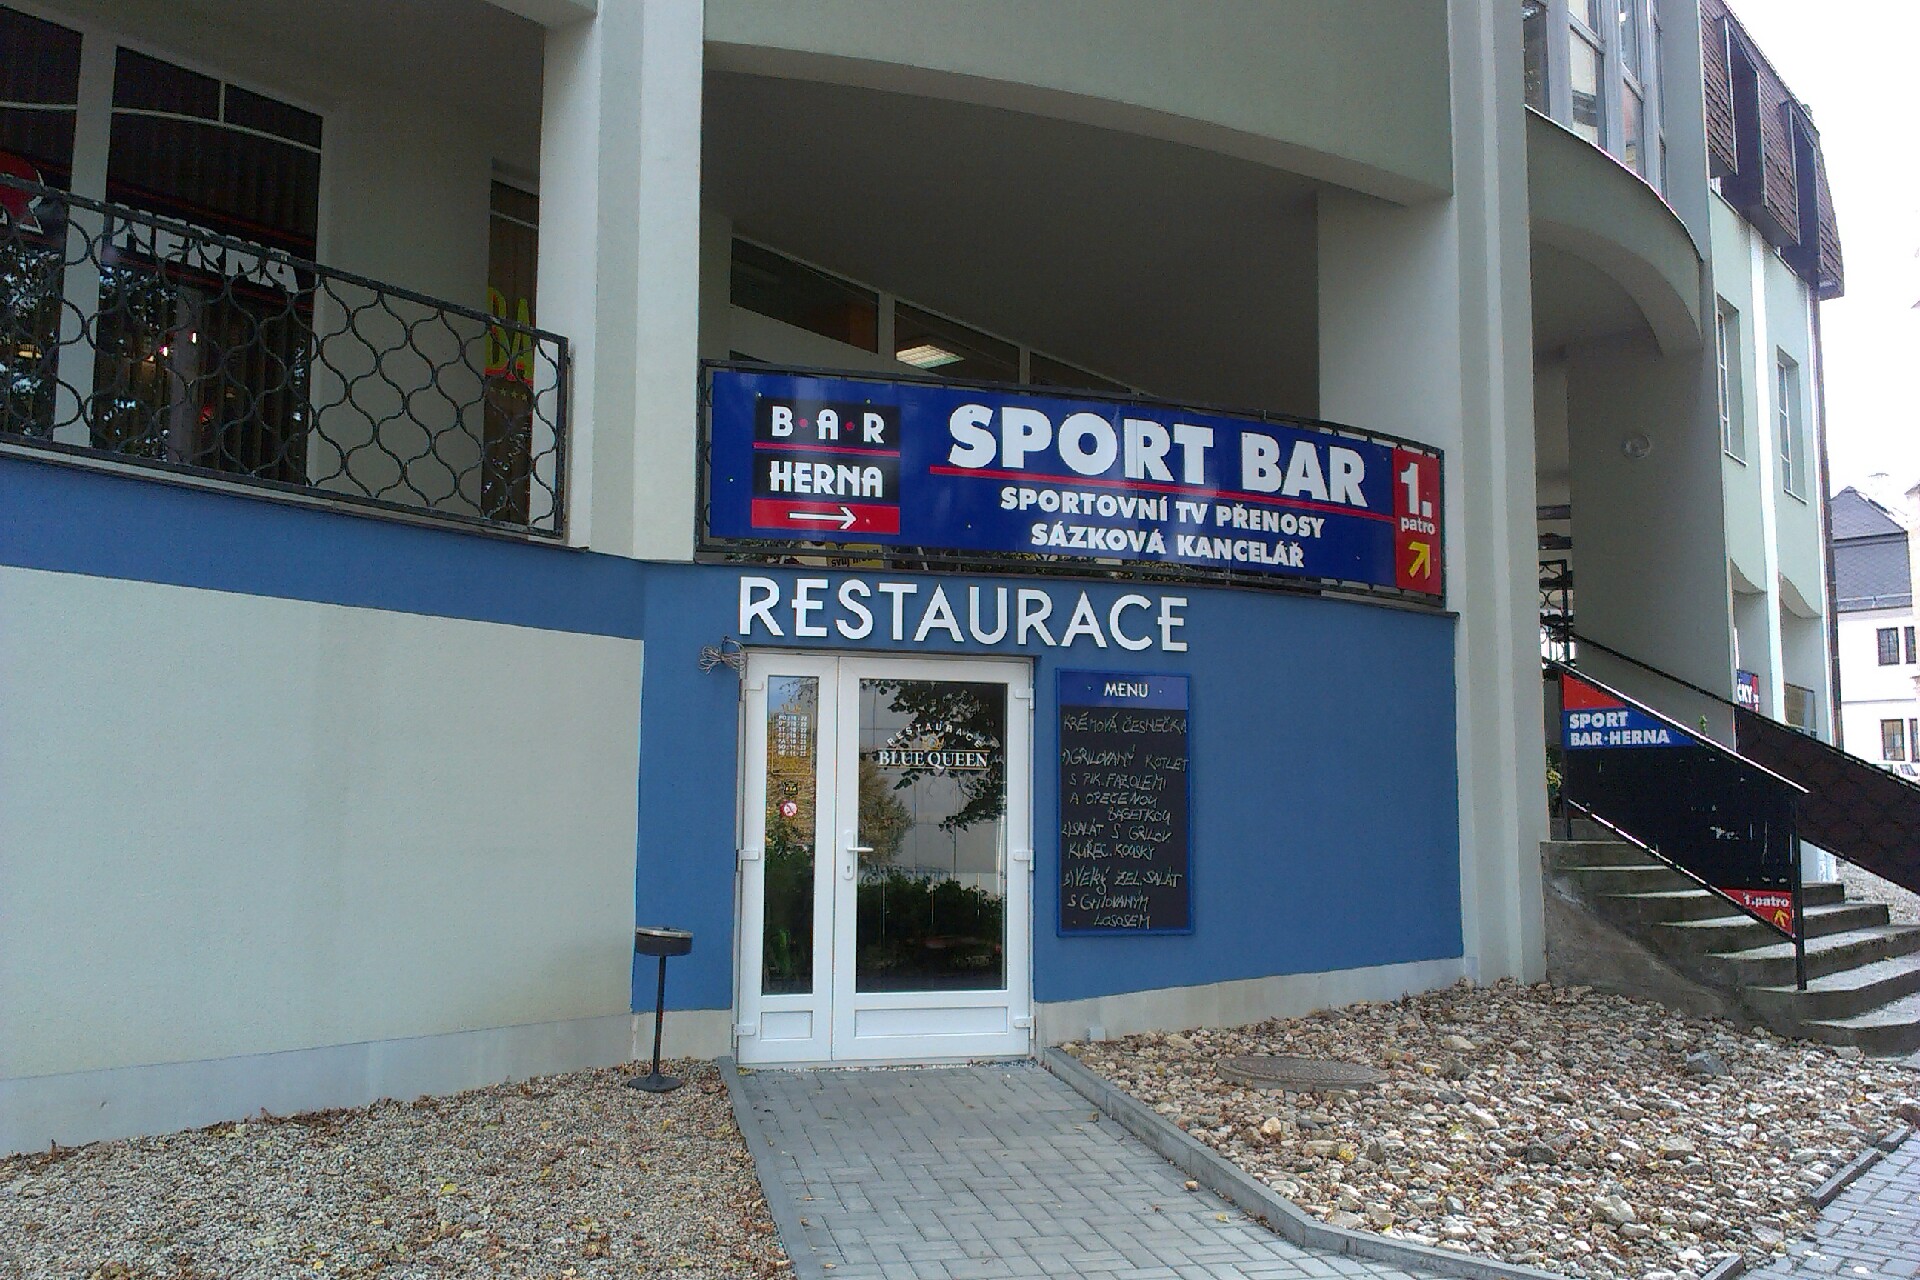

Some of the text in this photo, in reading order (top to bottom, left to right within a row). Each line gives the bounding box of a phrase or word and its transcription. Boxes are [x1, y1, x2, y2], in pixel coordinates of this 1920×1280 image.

[947, 403, 1368, 508] SPORT BAR
[769, 460, 883, 498] HERNA
[1401, 461, 1433, 518] 1.
[1001, 486, 1325, 539] SPORTOVNÍ TV PŘENOSY
[1401, 515, 1436, 535] patro
[1031, 520, 1305, 568] SÁZKOVÁ KANCELÁŘ
[739, 576, 1189, 653] RESTAURACE
[1104, 682, 1148, 698] MENU
[1569, 711, 1628, 729] SPORT
[887, 721, 985, 748] RESTAURACE
[879, 751, 988, 769] BLUE QUEEN
[1145, 754, 1189, 772] KOTLET
[1070, 792, 1079, 805] A
